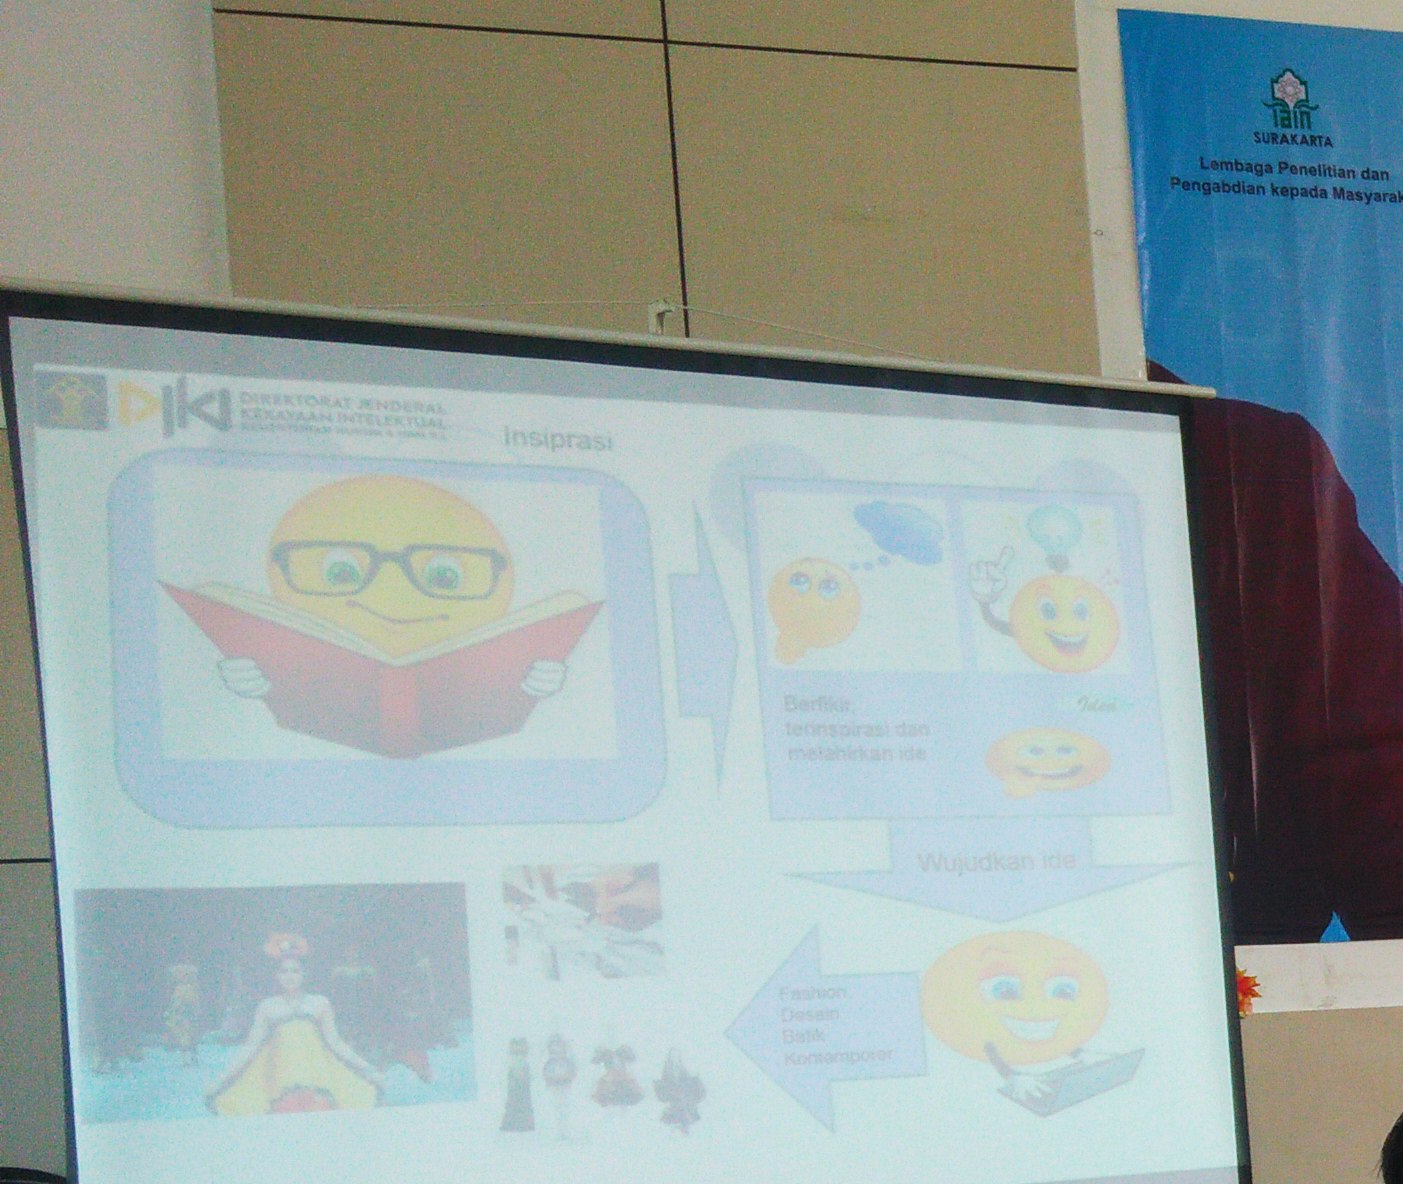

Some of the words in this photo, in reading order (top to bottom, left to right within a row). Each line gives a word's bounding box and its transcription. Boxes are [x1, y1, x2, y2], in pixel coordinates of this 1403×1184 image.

[1253, 131, 1334, 148] SURAKARTA
[1199, 156, 1274, 177] Lembaga
[1277, 160, 1356, 180] Penelitian
[1360, 166, 1390, 181] dan
[1169, 176, 1266, 196] Pengabdian
[1270, 182, 1328, 200] kepada
[917, 850, 1036, 878] Wujudkan
[1042, 850, 1077, 870] ide
